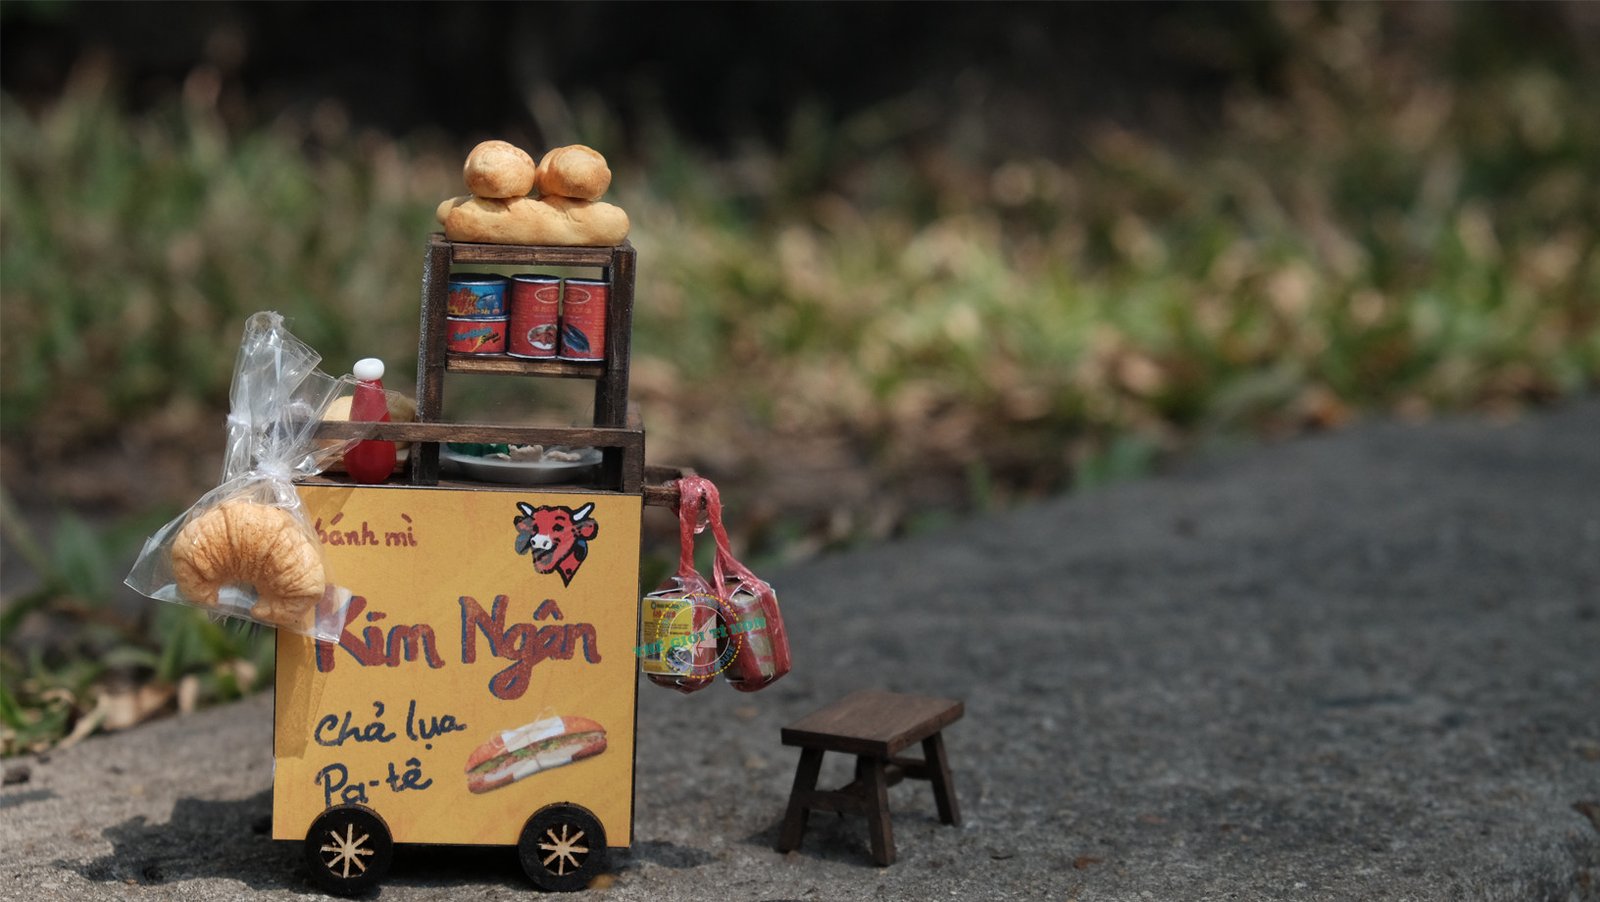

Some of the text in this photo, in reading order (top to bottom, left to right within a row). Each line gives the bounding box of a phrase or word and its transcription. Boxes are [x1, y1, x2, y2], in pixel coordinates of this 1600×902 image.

[314, 512, 418, 547] bánh mì
[458, 594, 602, 700] Ngân
[314, 700, 468, 750] Chả lụa
[314, 757, 433, 808] Pa-tê
